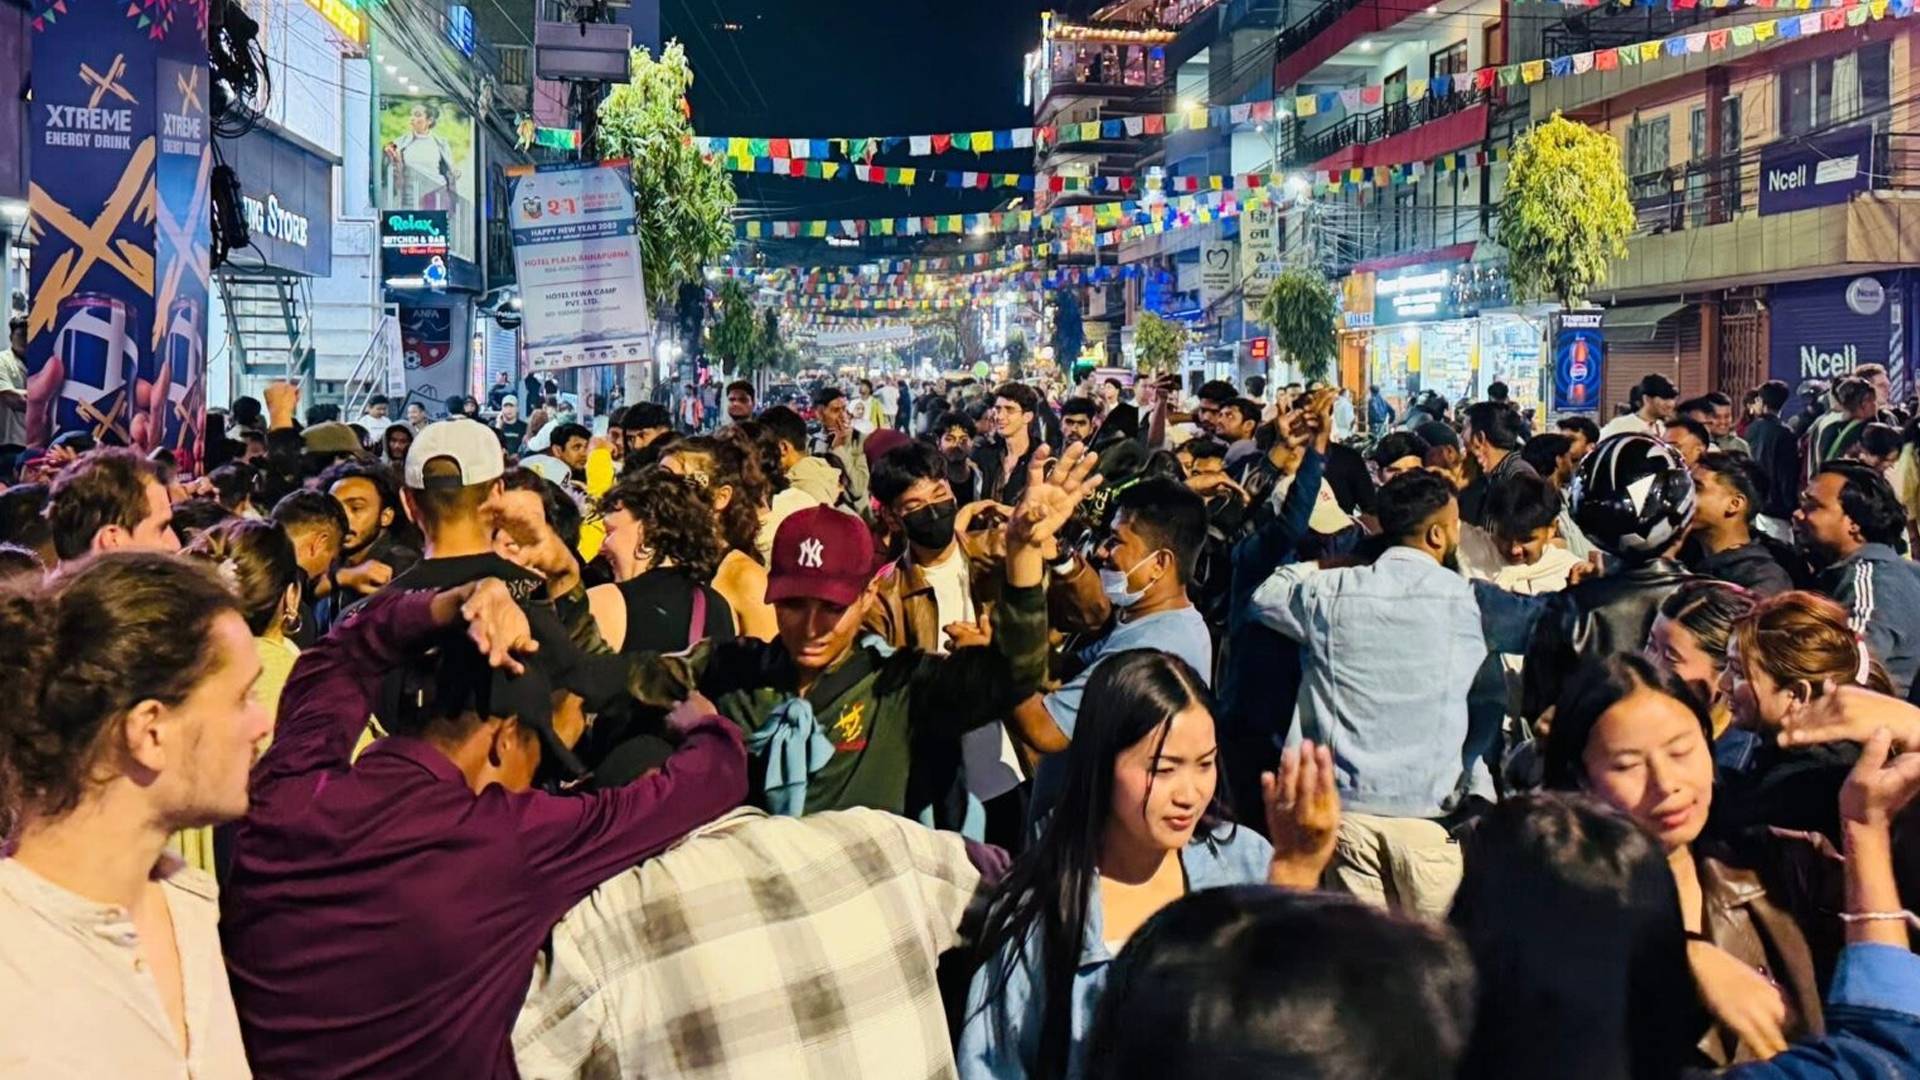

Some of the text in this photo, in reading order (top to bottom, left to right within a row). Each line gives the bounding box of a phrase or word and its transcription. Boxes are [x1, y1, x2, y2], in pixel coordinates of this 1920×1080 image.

[46, 104, 131, 131] XTREME
[163, 113, 201, 139] XTREME
[46, 131, 131, 149] ENERGY DRINK
[1768, 164, 1806, 192] Ncell
[389, 214, 440, 236] Relax
[531, 227, 557, 237] HAPPY
[558, 225, 576, 234] NEW
[577, 223, 597, 232] YEAR
[525, 259, 549, 267] HOTEL
[579, 250, 630, 262] ANNAPURNA
[545, 287, 617, 300] HOTEL FEWA CAMP
[412, 309, 440, 319] ANFA
[1561, 315, 1602, 324] THIRSTY
[1801, 344, 1857, 378] Ncell
[797, 537, 824, 568] NY
